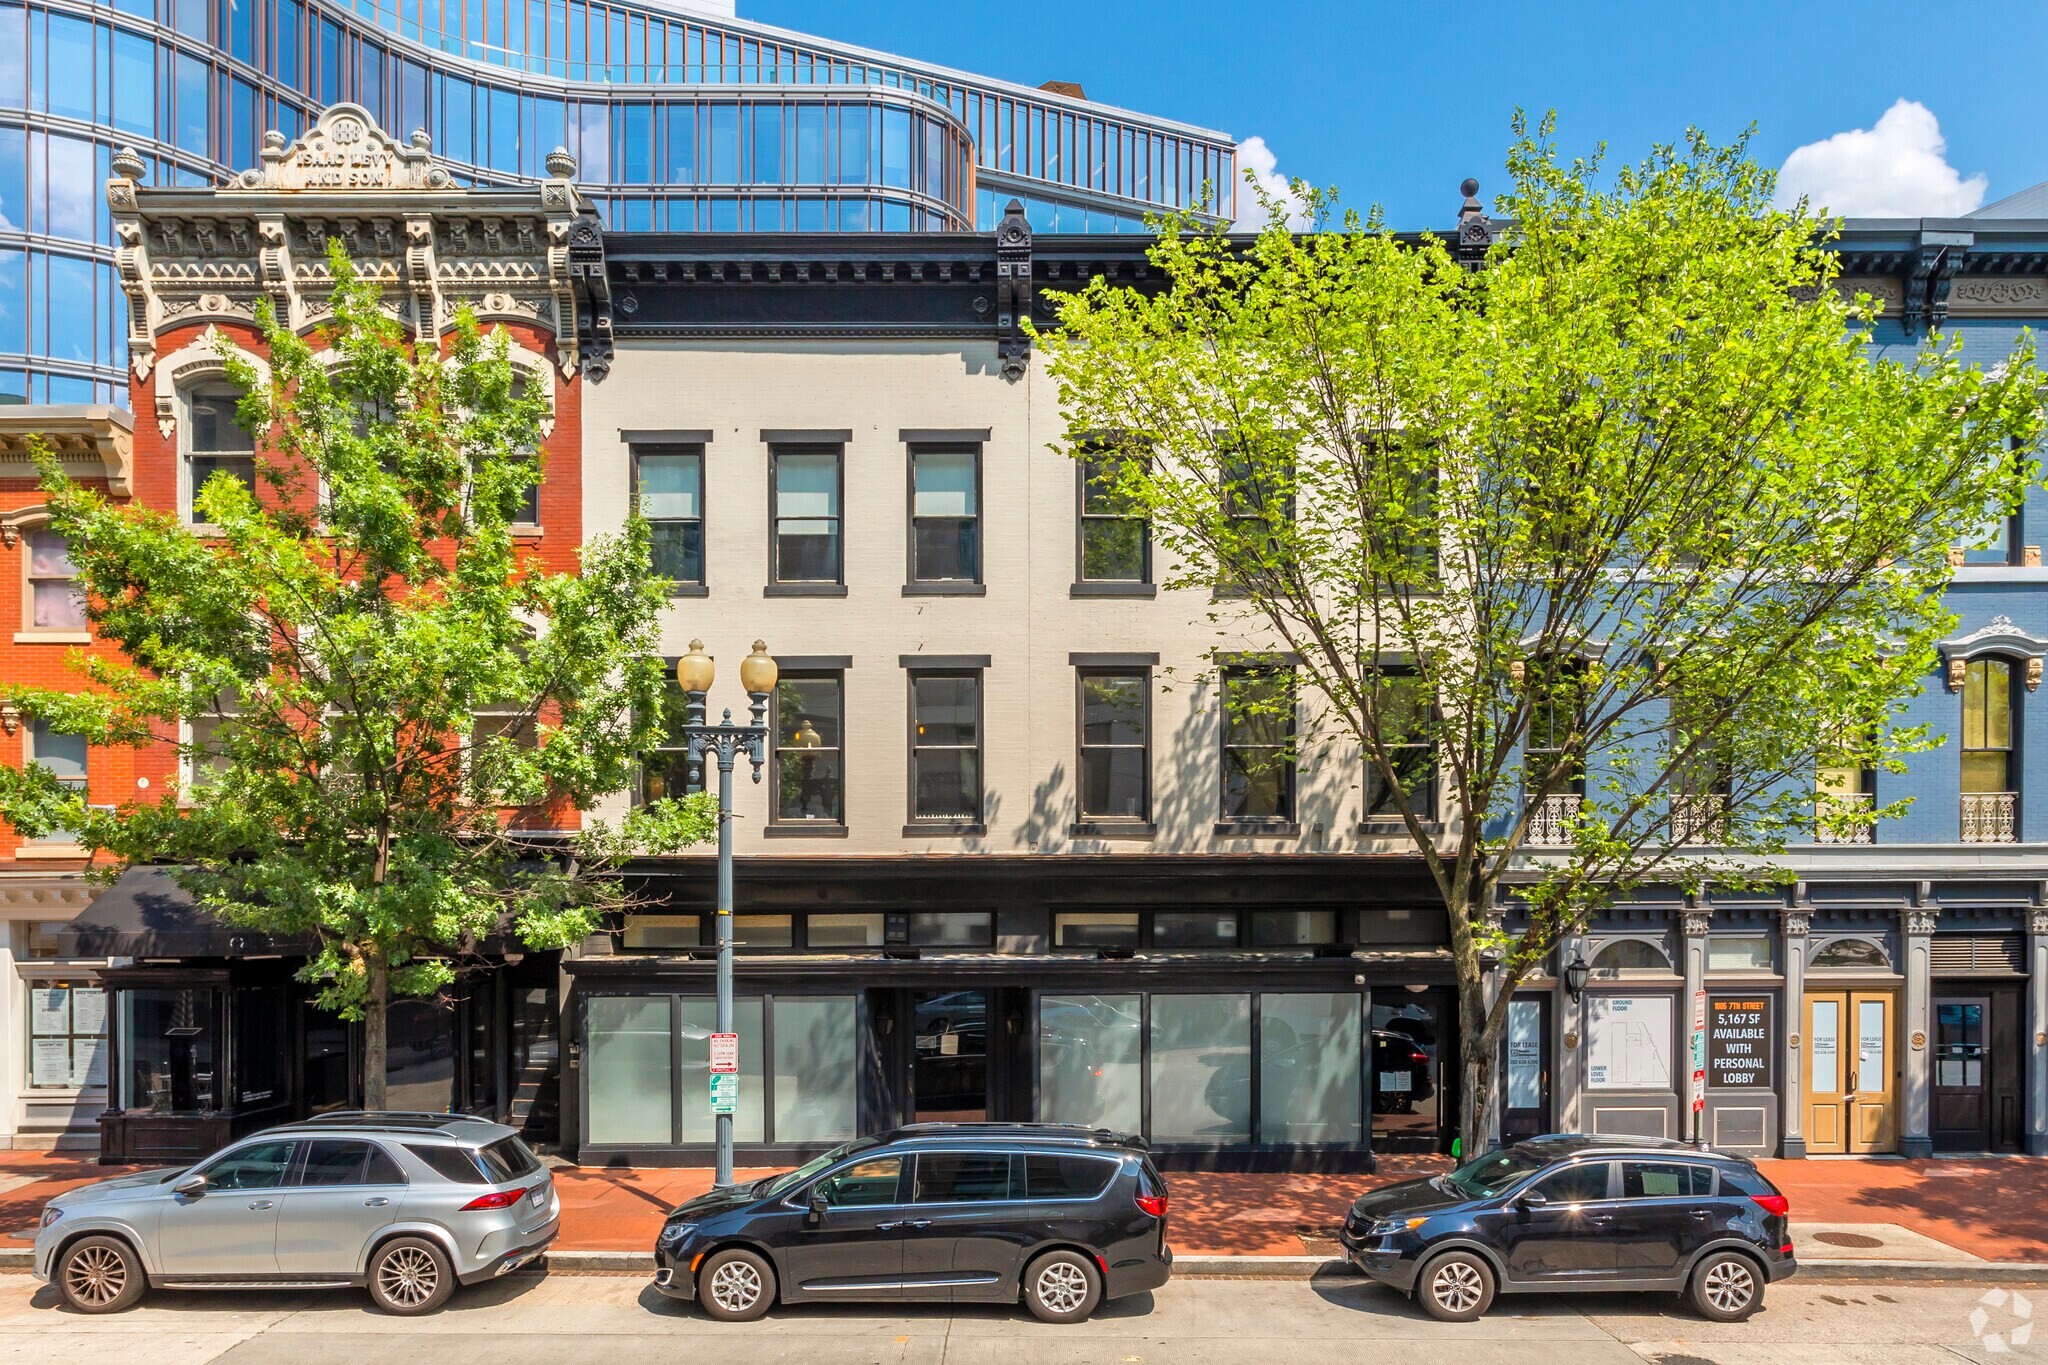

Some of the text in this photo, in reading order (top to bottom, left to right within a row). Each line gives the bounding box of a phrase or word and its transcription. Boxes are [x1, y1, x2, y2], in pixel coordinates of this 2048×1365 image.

[297, 154, 393, 168] ISAAC LEVY
[305, 173, 342, 187] AND
[1729, 1002, 1740, 1010] 7TH
[1742, 1002, 1764, 1010] STREET
[1718, 1014, 1760, 1025] 5,167 SF
[1713, 1029, 1764, 1038] AVAILABLE
[1726, 1044, 1751, 1053] WITH
[1714, 1058, 1764, 1068] PERSONAL
[1724, 1073, 1755, 1083] LOBBY
